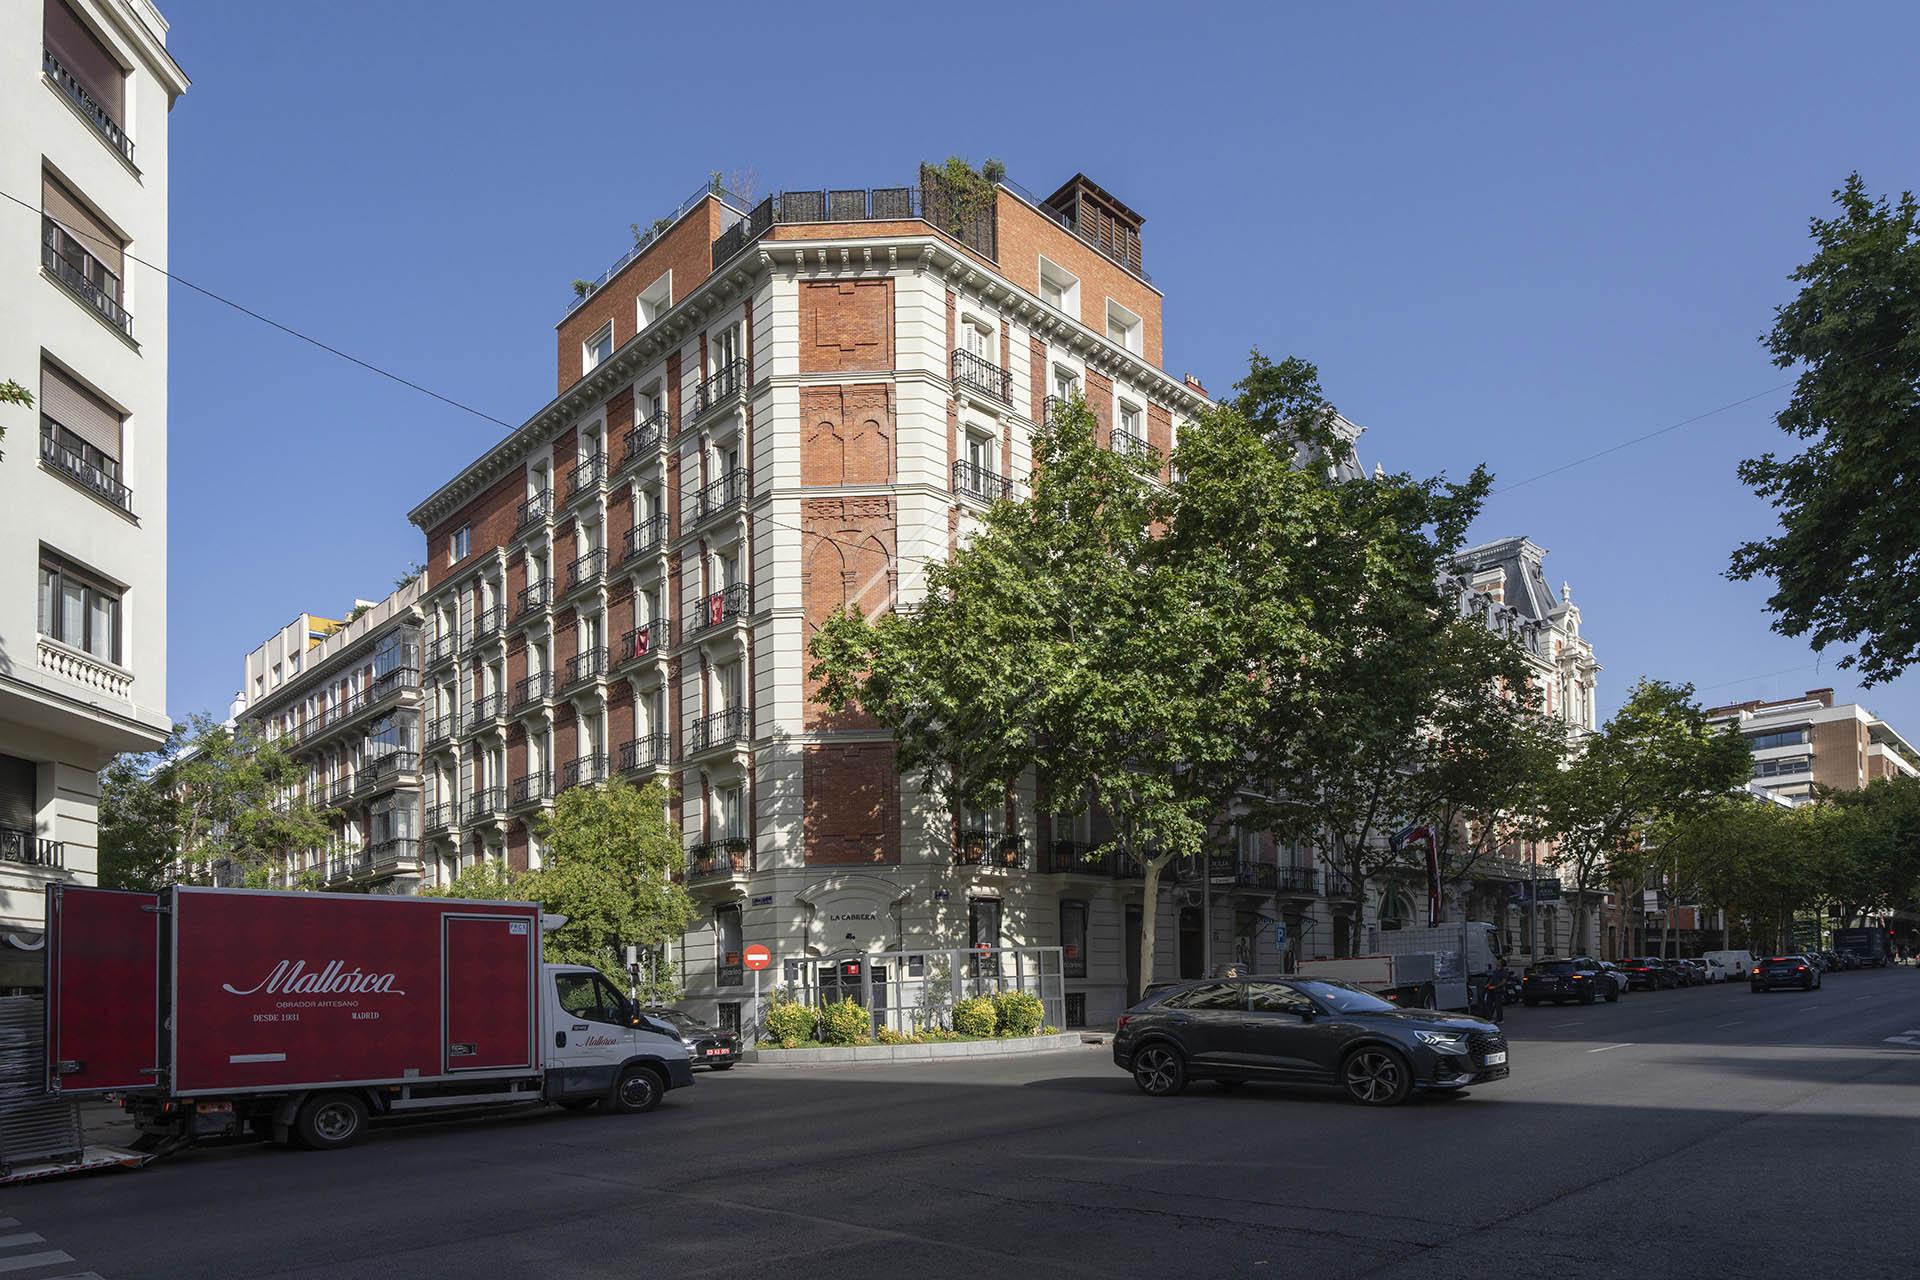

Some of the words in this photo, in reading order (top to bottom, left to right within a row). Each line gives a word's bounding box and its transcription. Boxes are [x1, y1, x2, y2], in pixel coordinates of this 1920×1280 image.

[841, 913, 876, 921] CABRERA
[222, 959, 406, 995] Mallorca
[276, 1000, 316, 1009] OBRADOR
[317, 1000, 359, 1008] ARTESANO
[253, 1013, 279, 1022] DESDE
[281, 1013, 300, 1022] 1931
[351, 1012, 380, 1020] MADRID
[575, 1034, 617, 1047] Mallorca
